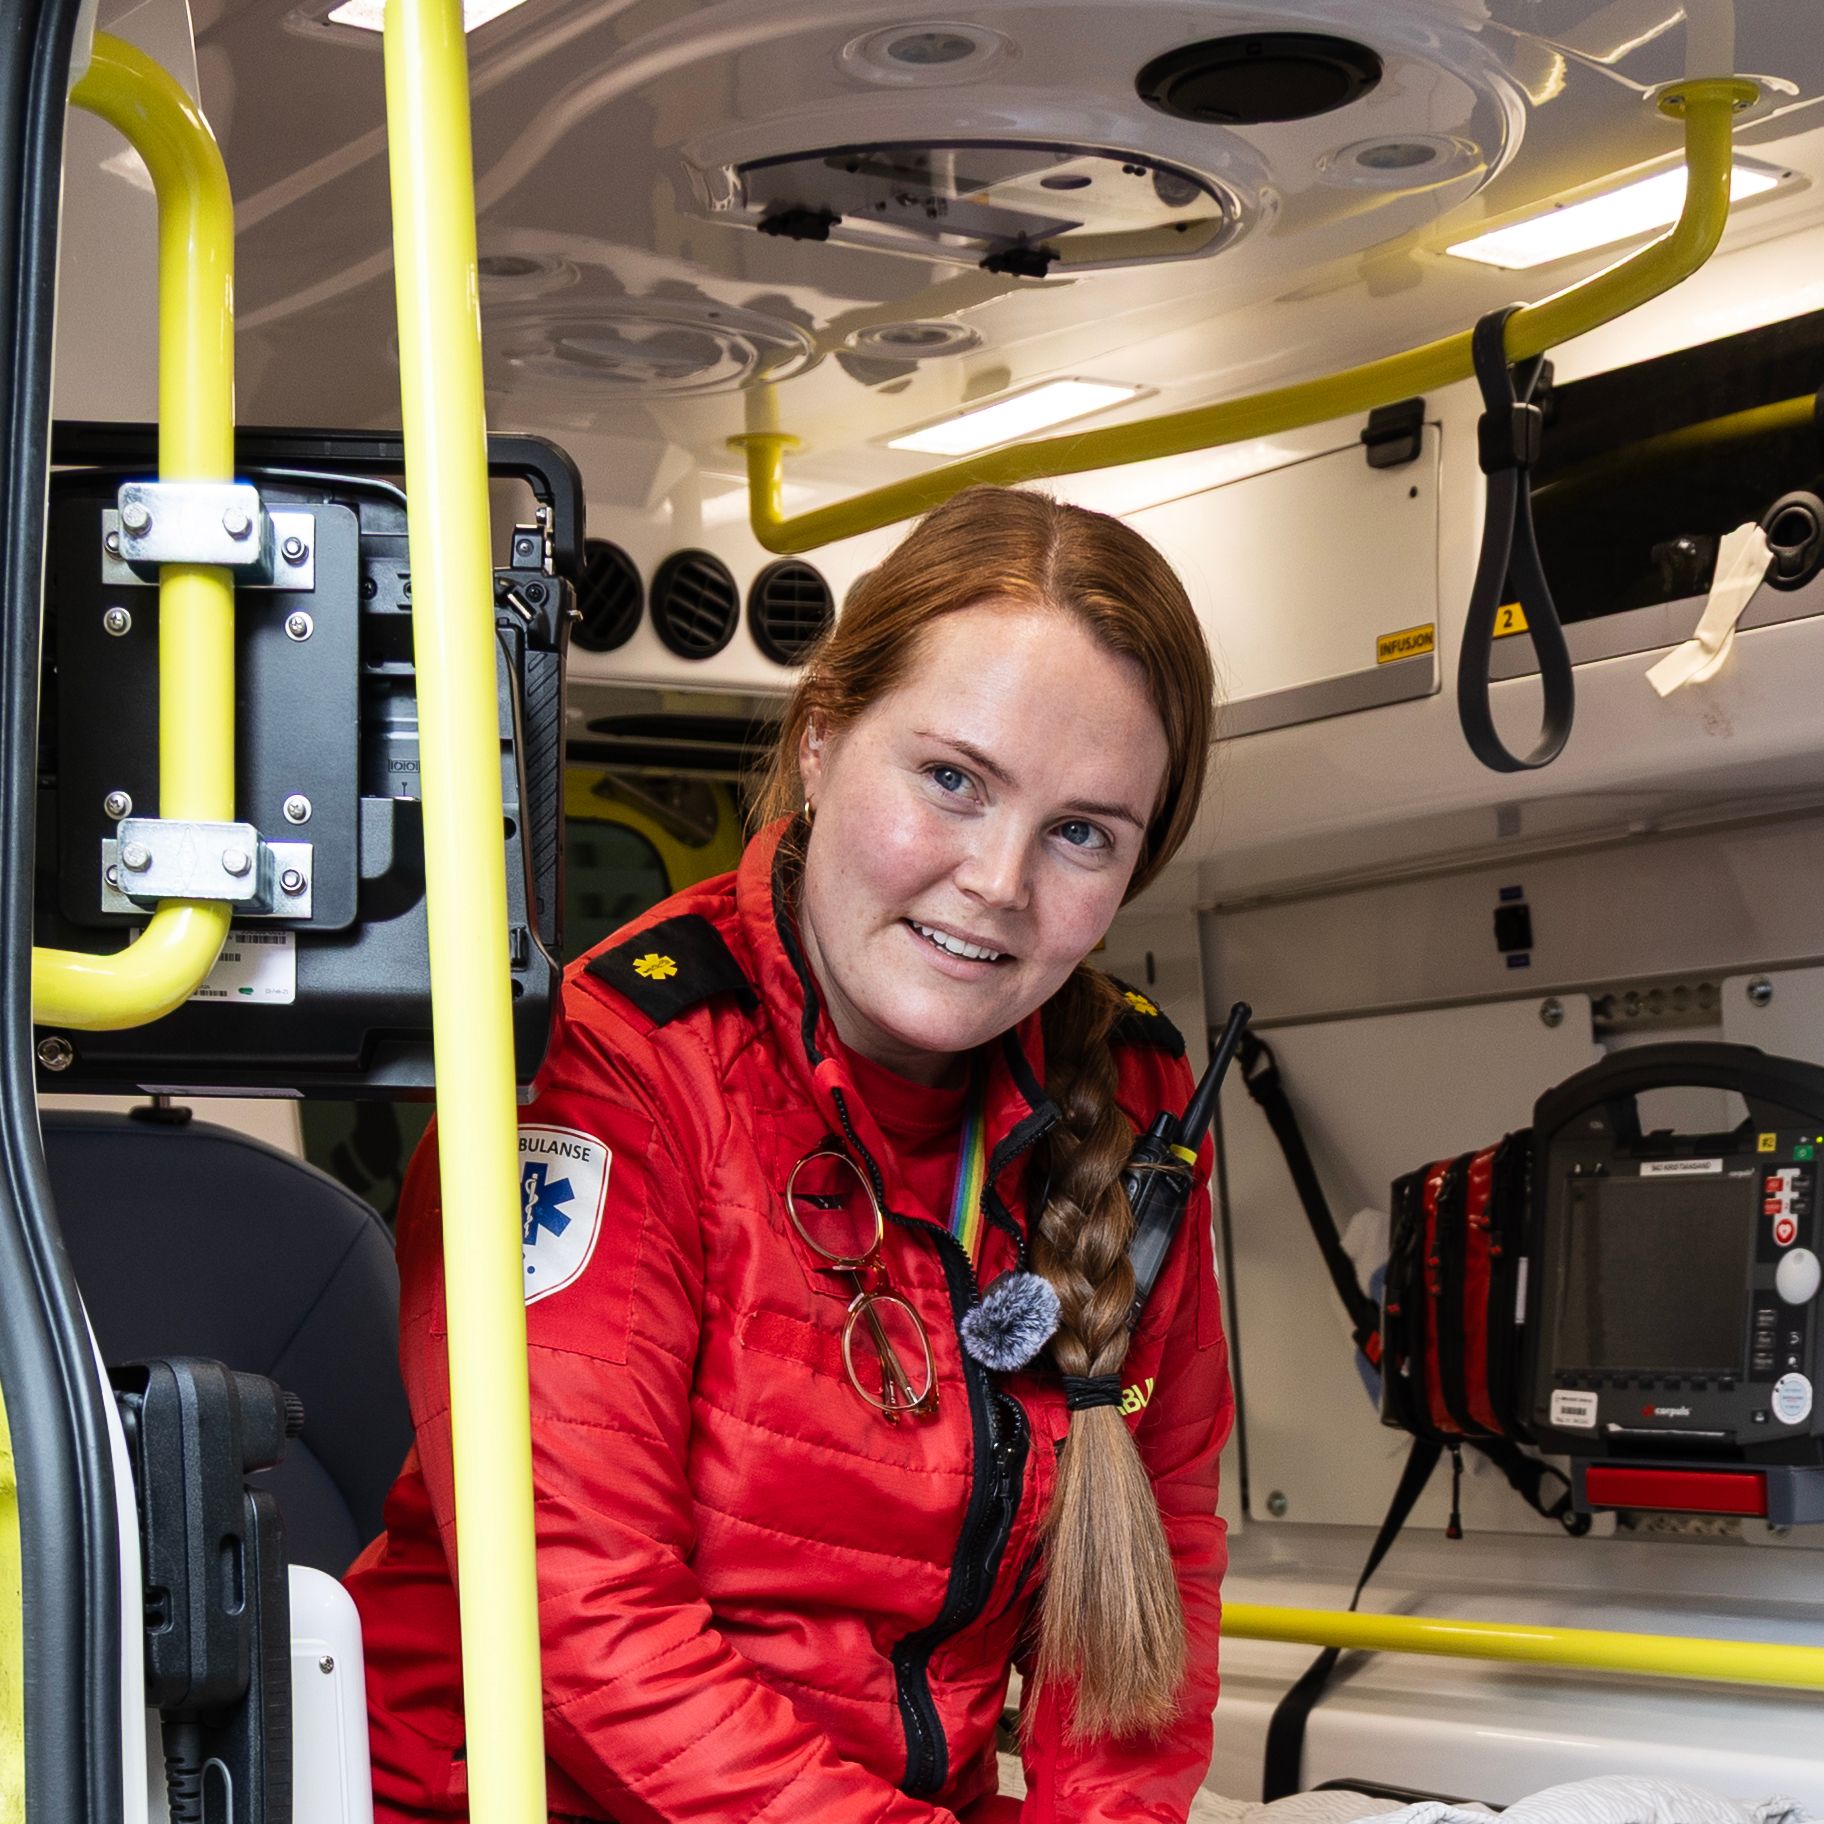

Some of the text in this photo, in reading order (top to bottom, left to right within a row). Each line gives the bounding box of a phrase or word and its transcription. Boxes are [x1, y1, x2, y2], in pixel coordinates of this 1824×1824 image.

[1503, 609, 1513, 628] 2
[1379, 630, 1434, 657] INFUSJON
[1654, 1406, 1691, 1418] corpuls
